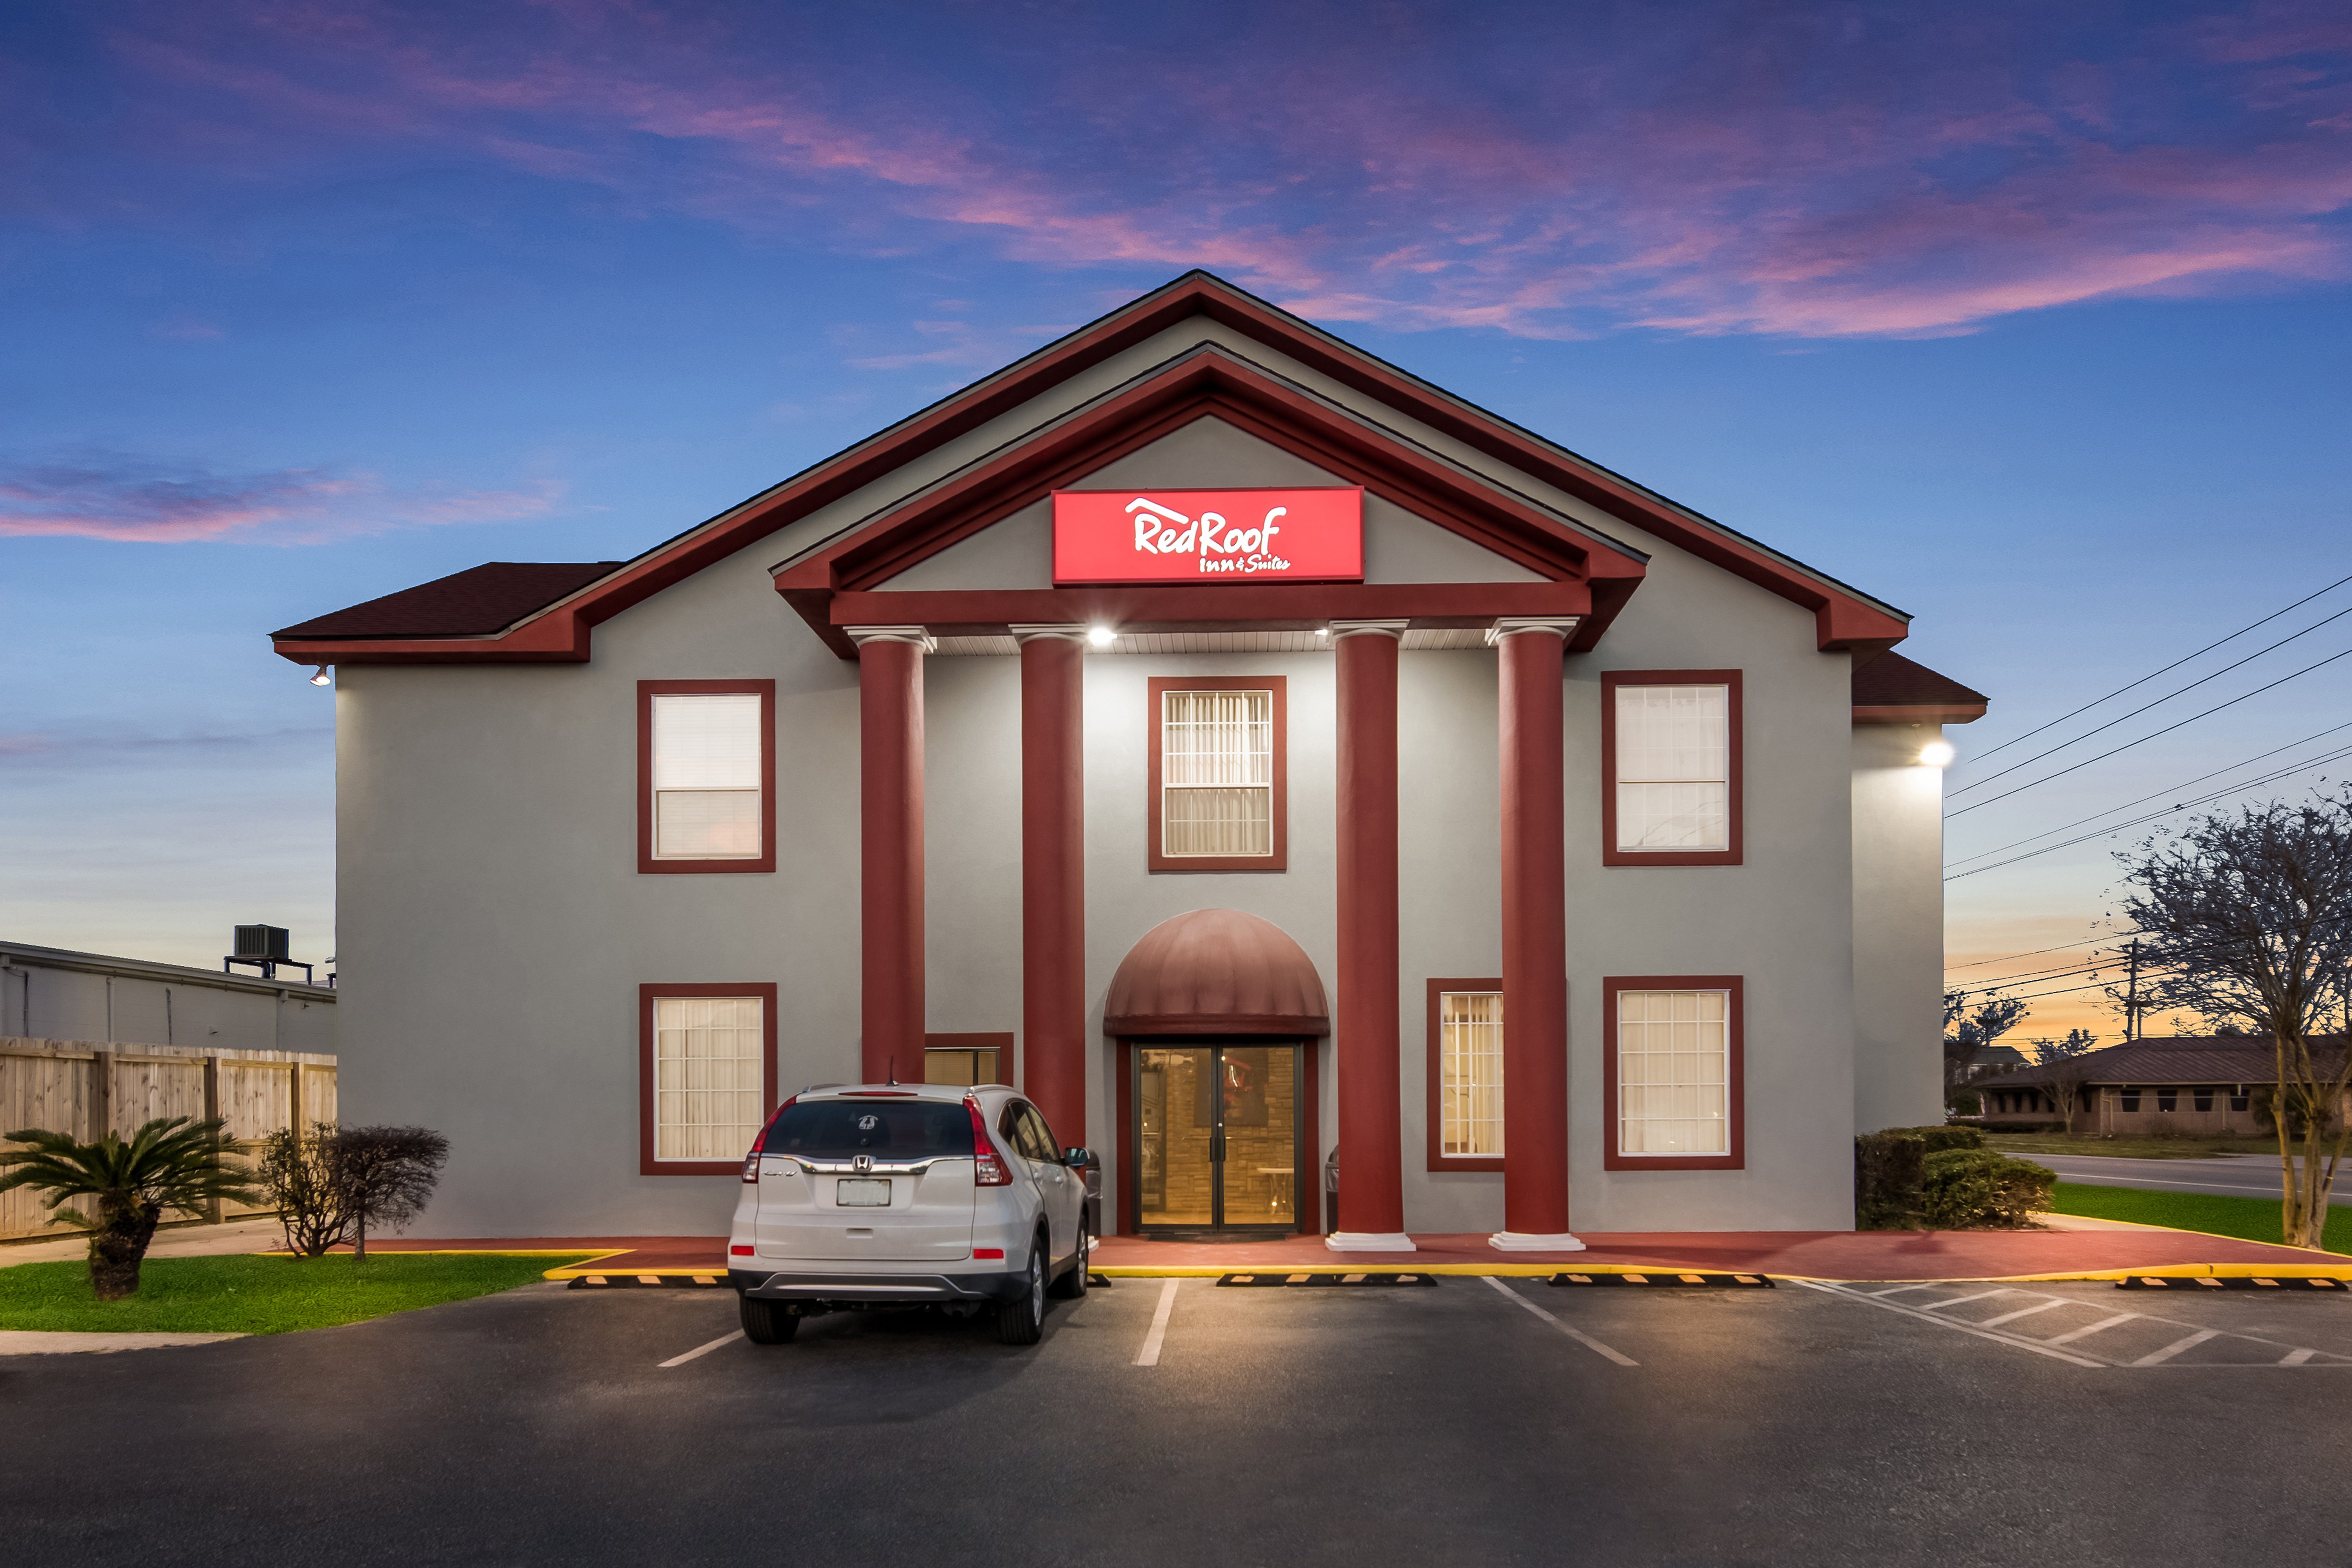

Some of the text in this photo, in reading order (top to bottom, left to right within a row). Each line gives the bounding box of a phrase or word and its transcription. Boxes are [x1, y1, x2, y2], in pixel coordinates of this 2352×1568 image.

[1134, 507, 1287, 556] Red Roof
[1244, 554, 1291, 573] Suites
